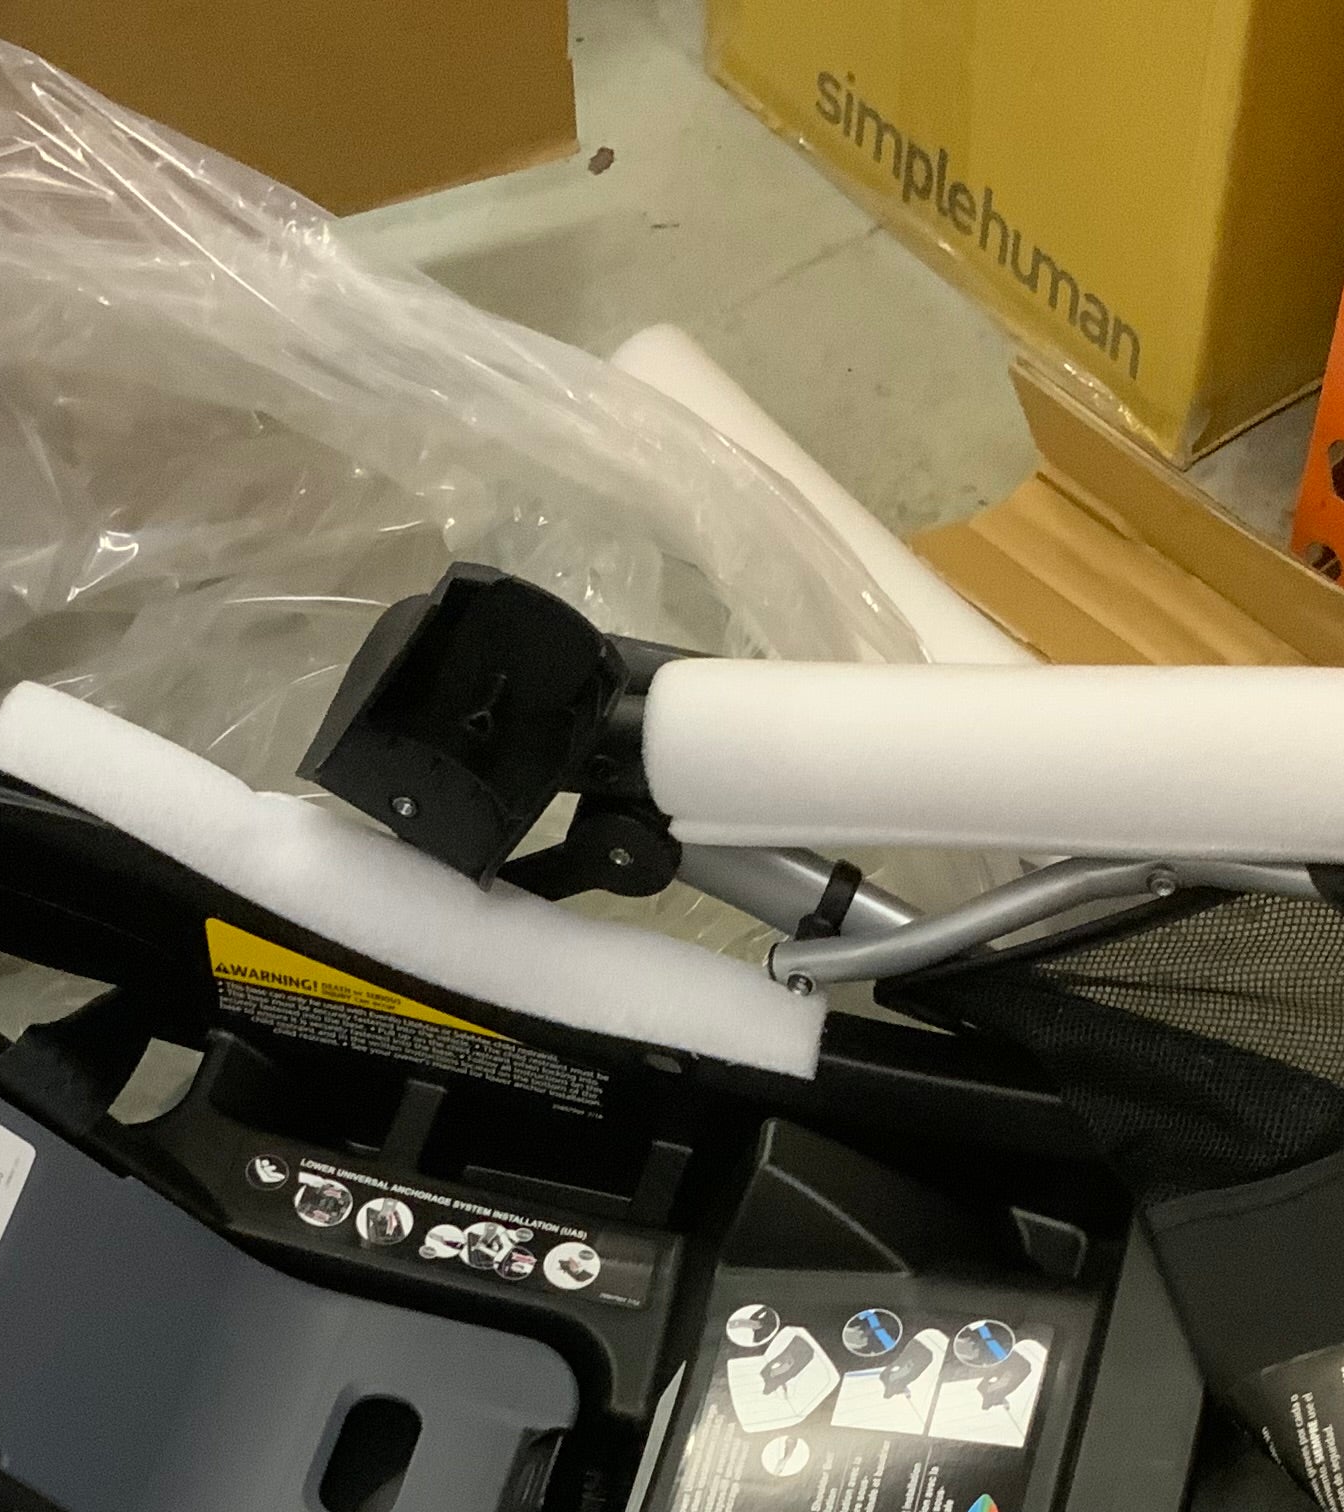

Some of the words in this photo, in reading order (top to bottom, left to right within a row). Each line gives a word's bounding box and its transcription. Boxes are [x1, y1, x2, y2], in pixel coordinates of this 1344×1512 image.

[815, 70, 1142, 380] simplehuman
[229, 963, 320, 992] WARNING!
[299, 1157, 336, 1175] LOWER
[336, 1168, 389, 1190] UNIVERSAL
[389, 1183, 451, 1206] ANCHORAGE
[451, 1199, 492, 1216] SYSTEM
[1306, 1418, 1324, 1464] SIEMPRE
